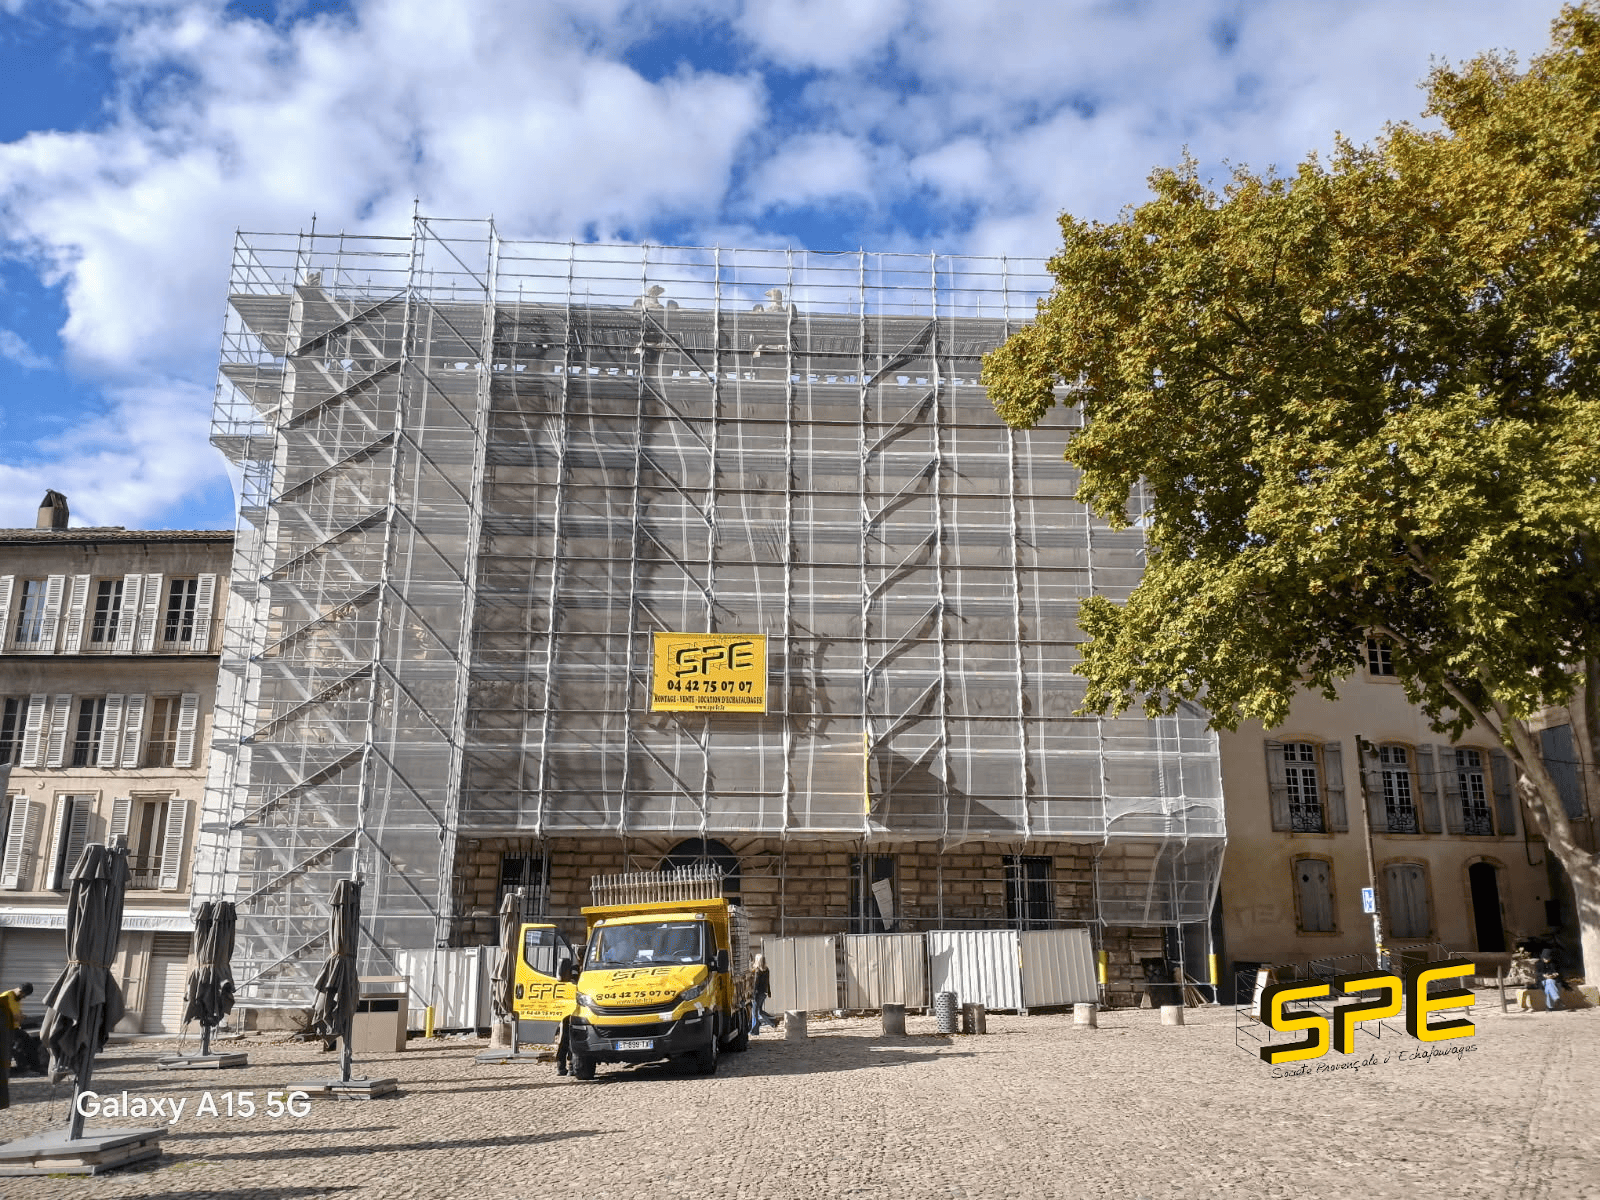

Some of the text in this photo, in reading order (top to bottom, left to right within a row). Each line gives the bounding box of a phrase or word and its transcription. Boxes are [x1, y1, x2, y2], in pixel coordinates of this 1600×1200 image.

[675, 641, 754, 678] SPE
[667, 680, 752, 693] 04 42 75 07 07
[654, 695, 677, 703] MONTAGE
[680, 695, 695, 703] VENTE
[698, 695, 720, 704] LOCATION
[612, 967, 672, 981] SPE
[528, 983, 566, 1000] SPE
